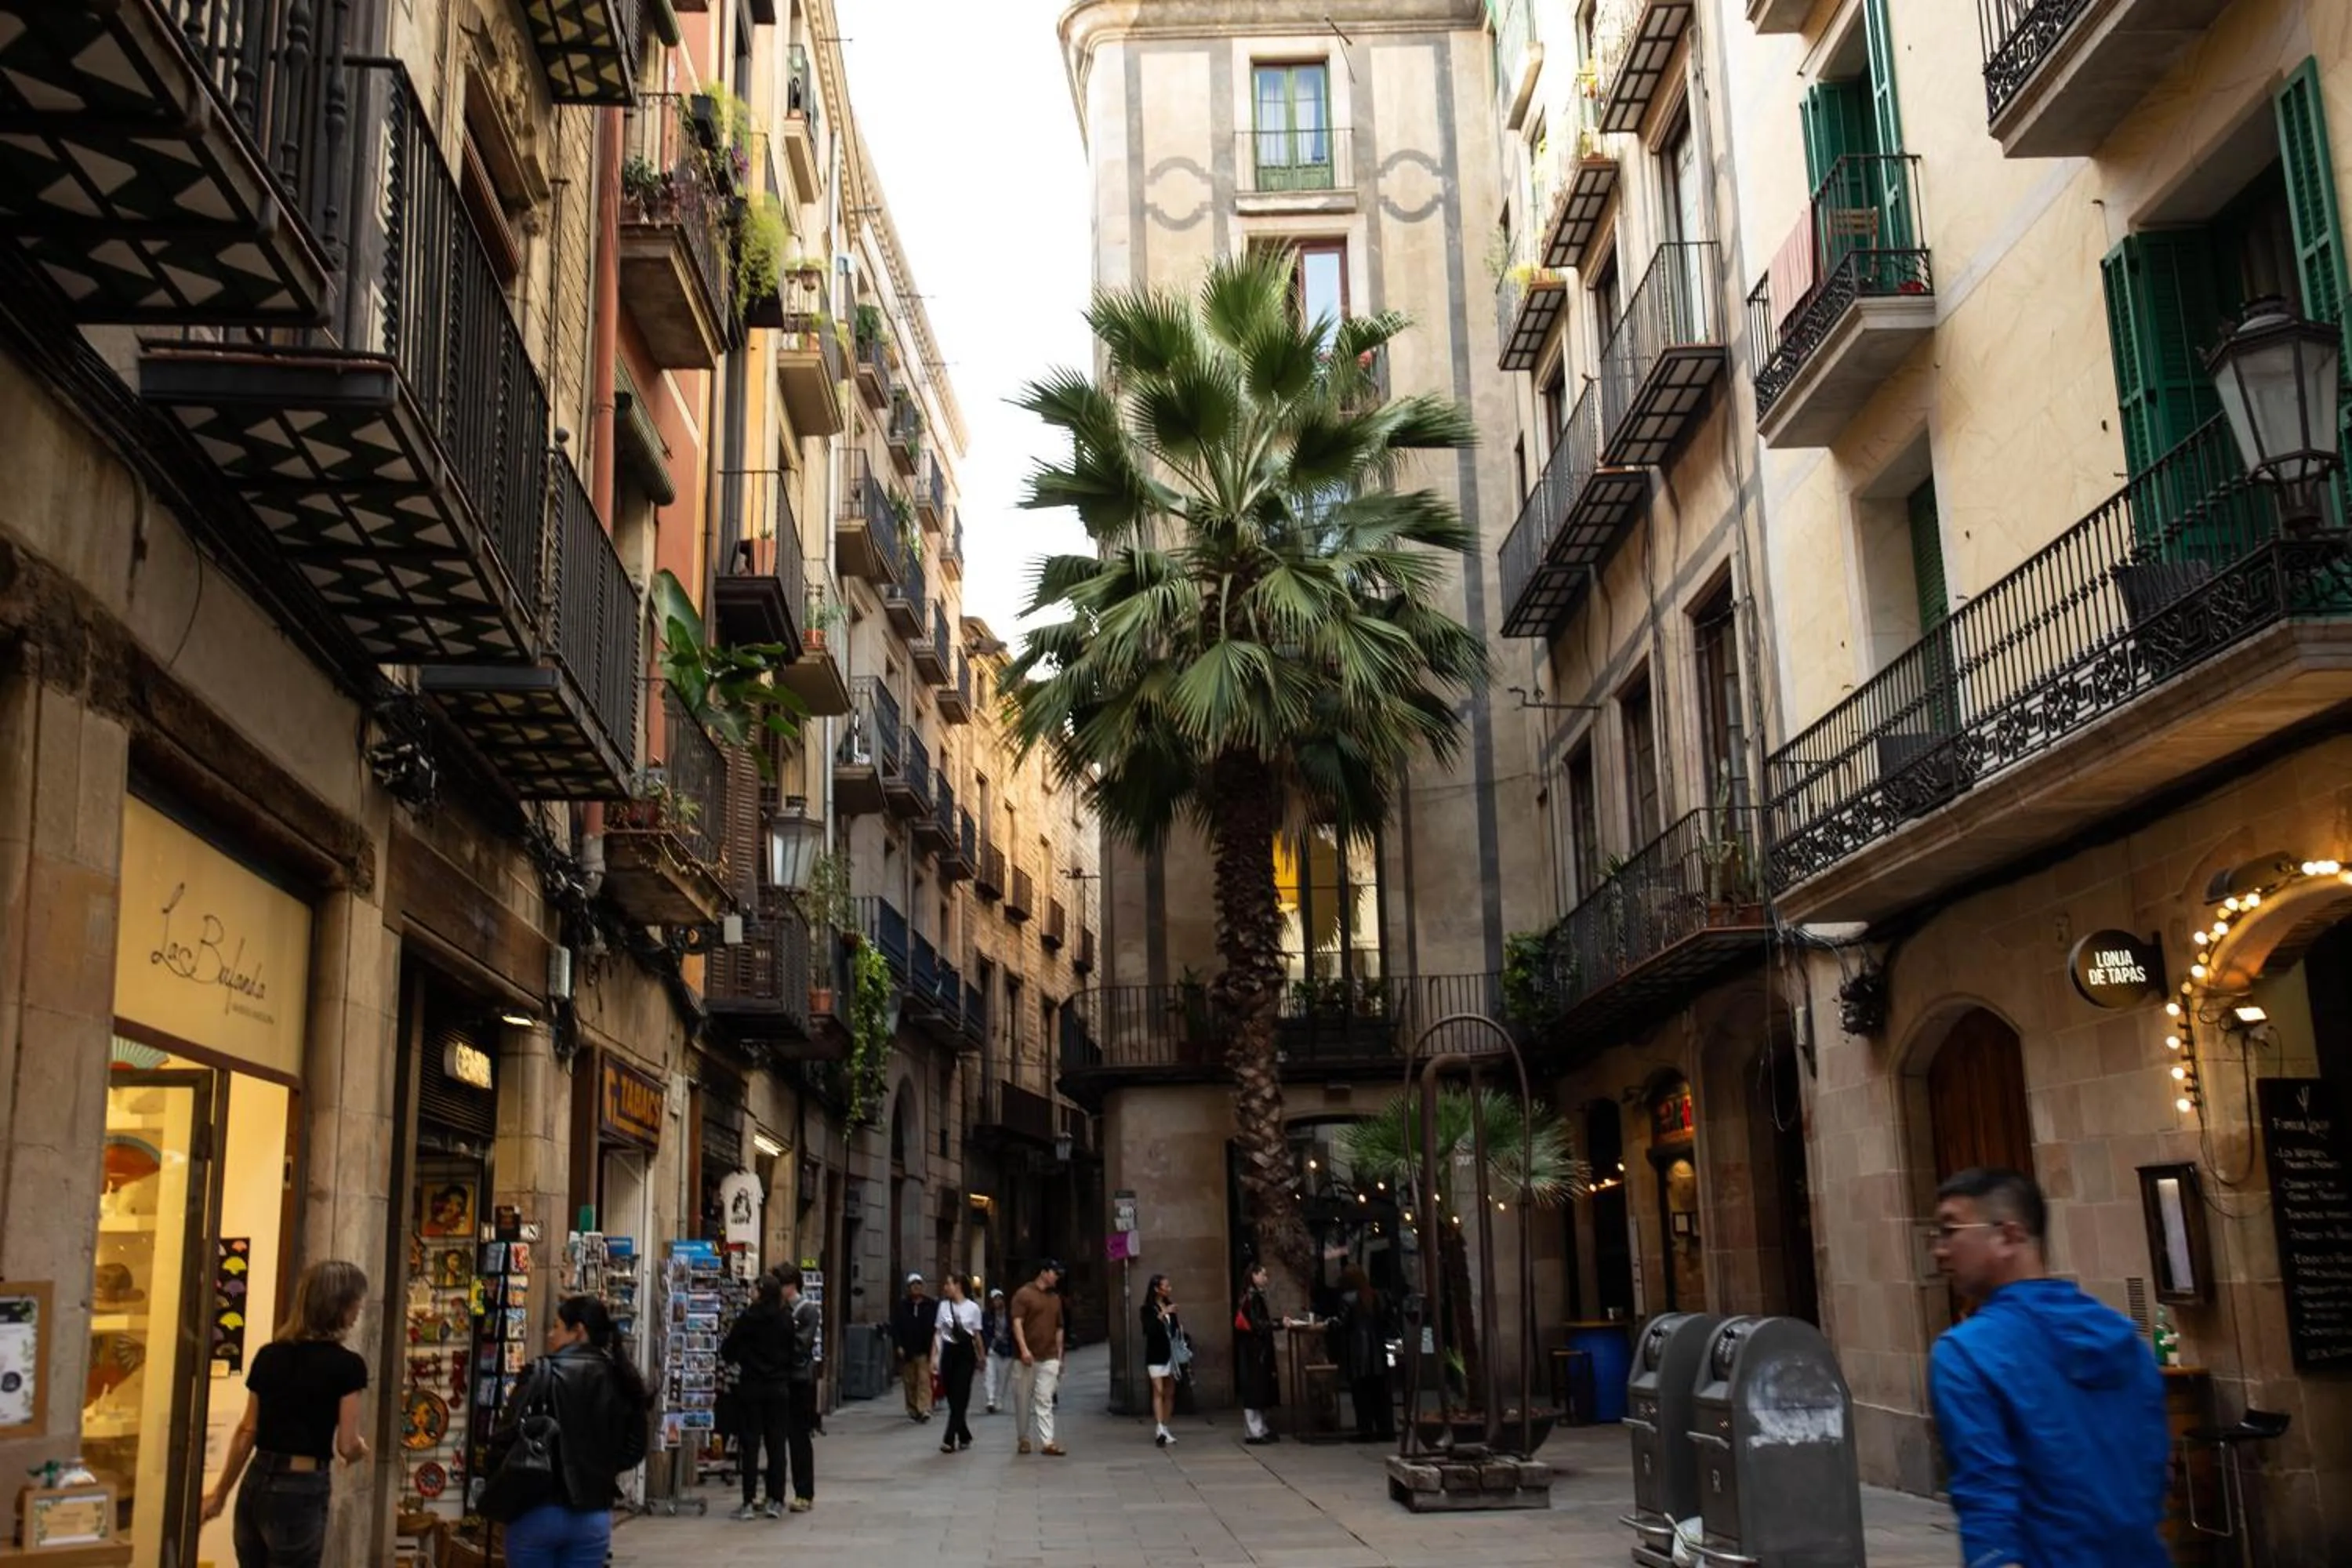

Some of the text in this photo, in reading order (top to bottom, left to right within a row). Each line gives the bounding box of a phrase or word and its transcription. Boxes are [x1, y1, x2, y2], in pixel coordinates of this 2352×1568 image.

[2095, 950, 2133, 967] LONJA
[2089, 966, 2146, 985] DE TAPAS
[622, 1075, 662, 1131] TABACS
